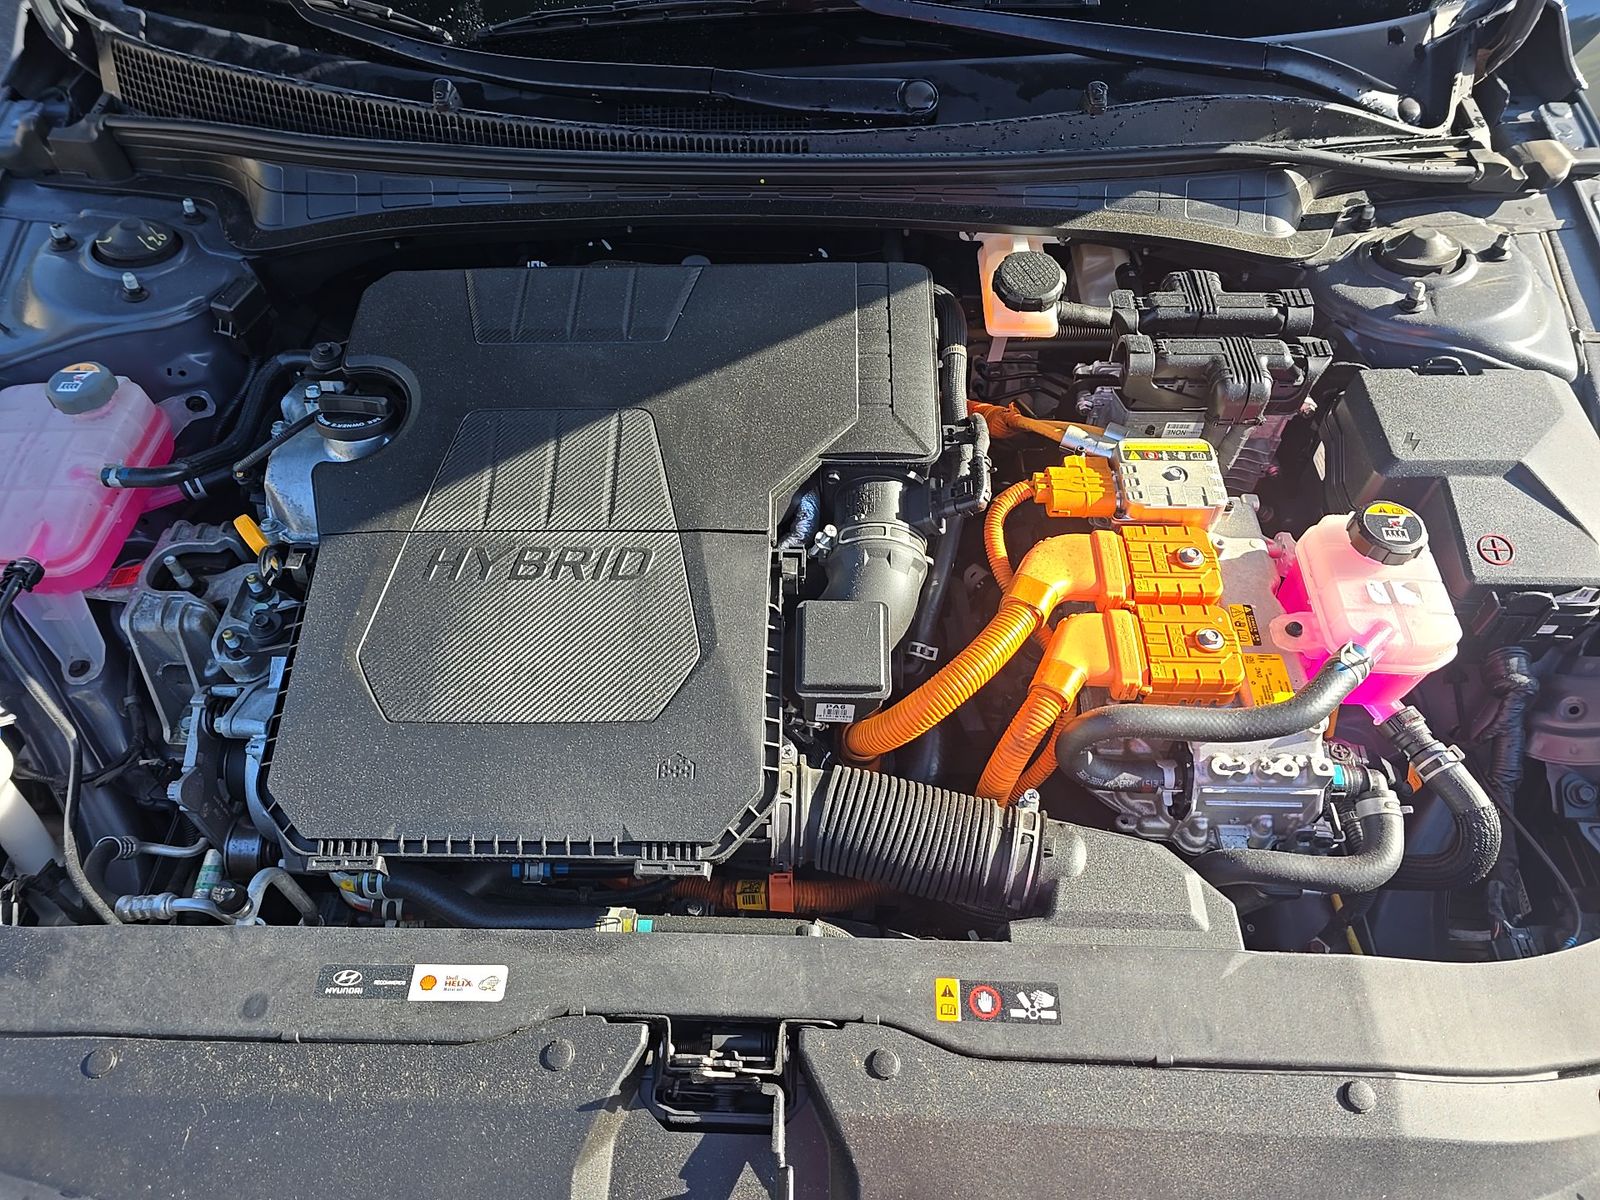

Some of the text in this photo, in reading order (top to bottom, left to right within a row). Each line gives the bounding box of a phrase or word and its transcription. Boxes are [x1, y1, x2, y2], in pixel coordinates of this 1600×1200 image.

[422, 546, 654, 582] HYBRID
[444, 979, 472, 987] HELIX
[325, 987, 363, 995] HYUNDAI
